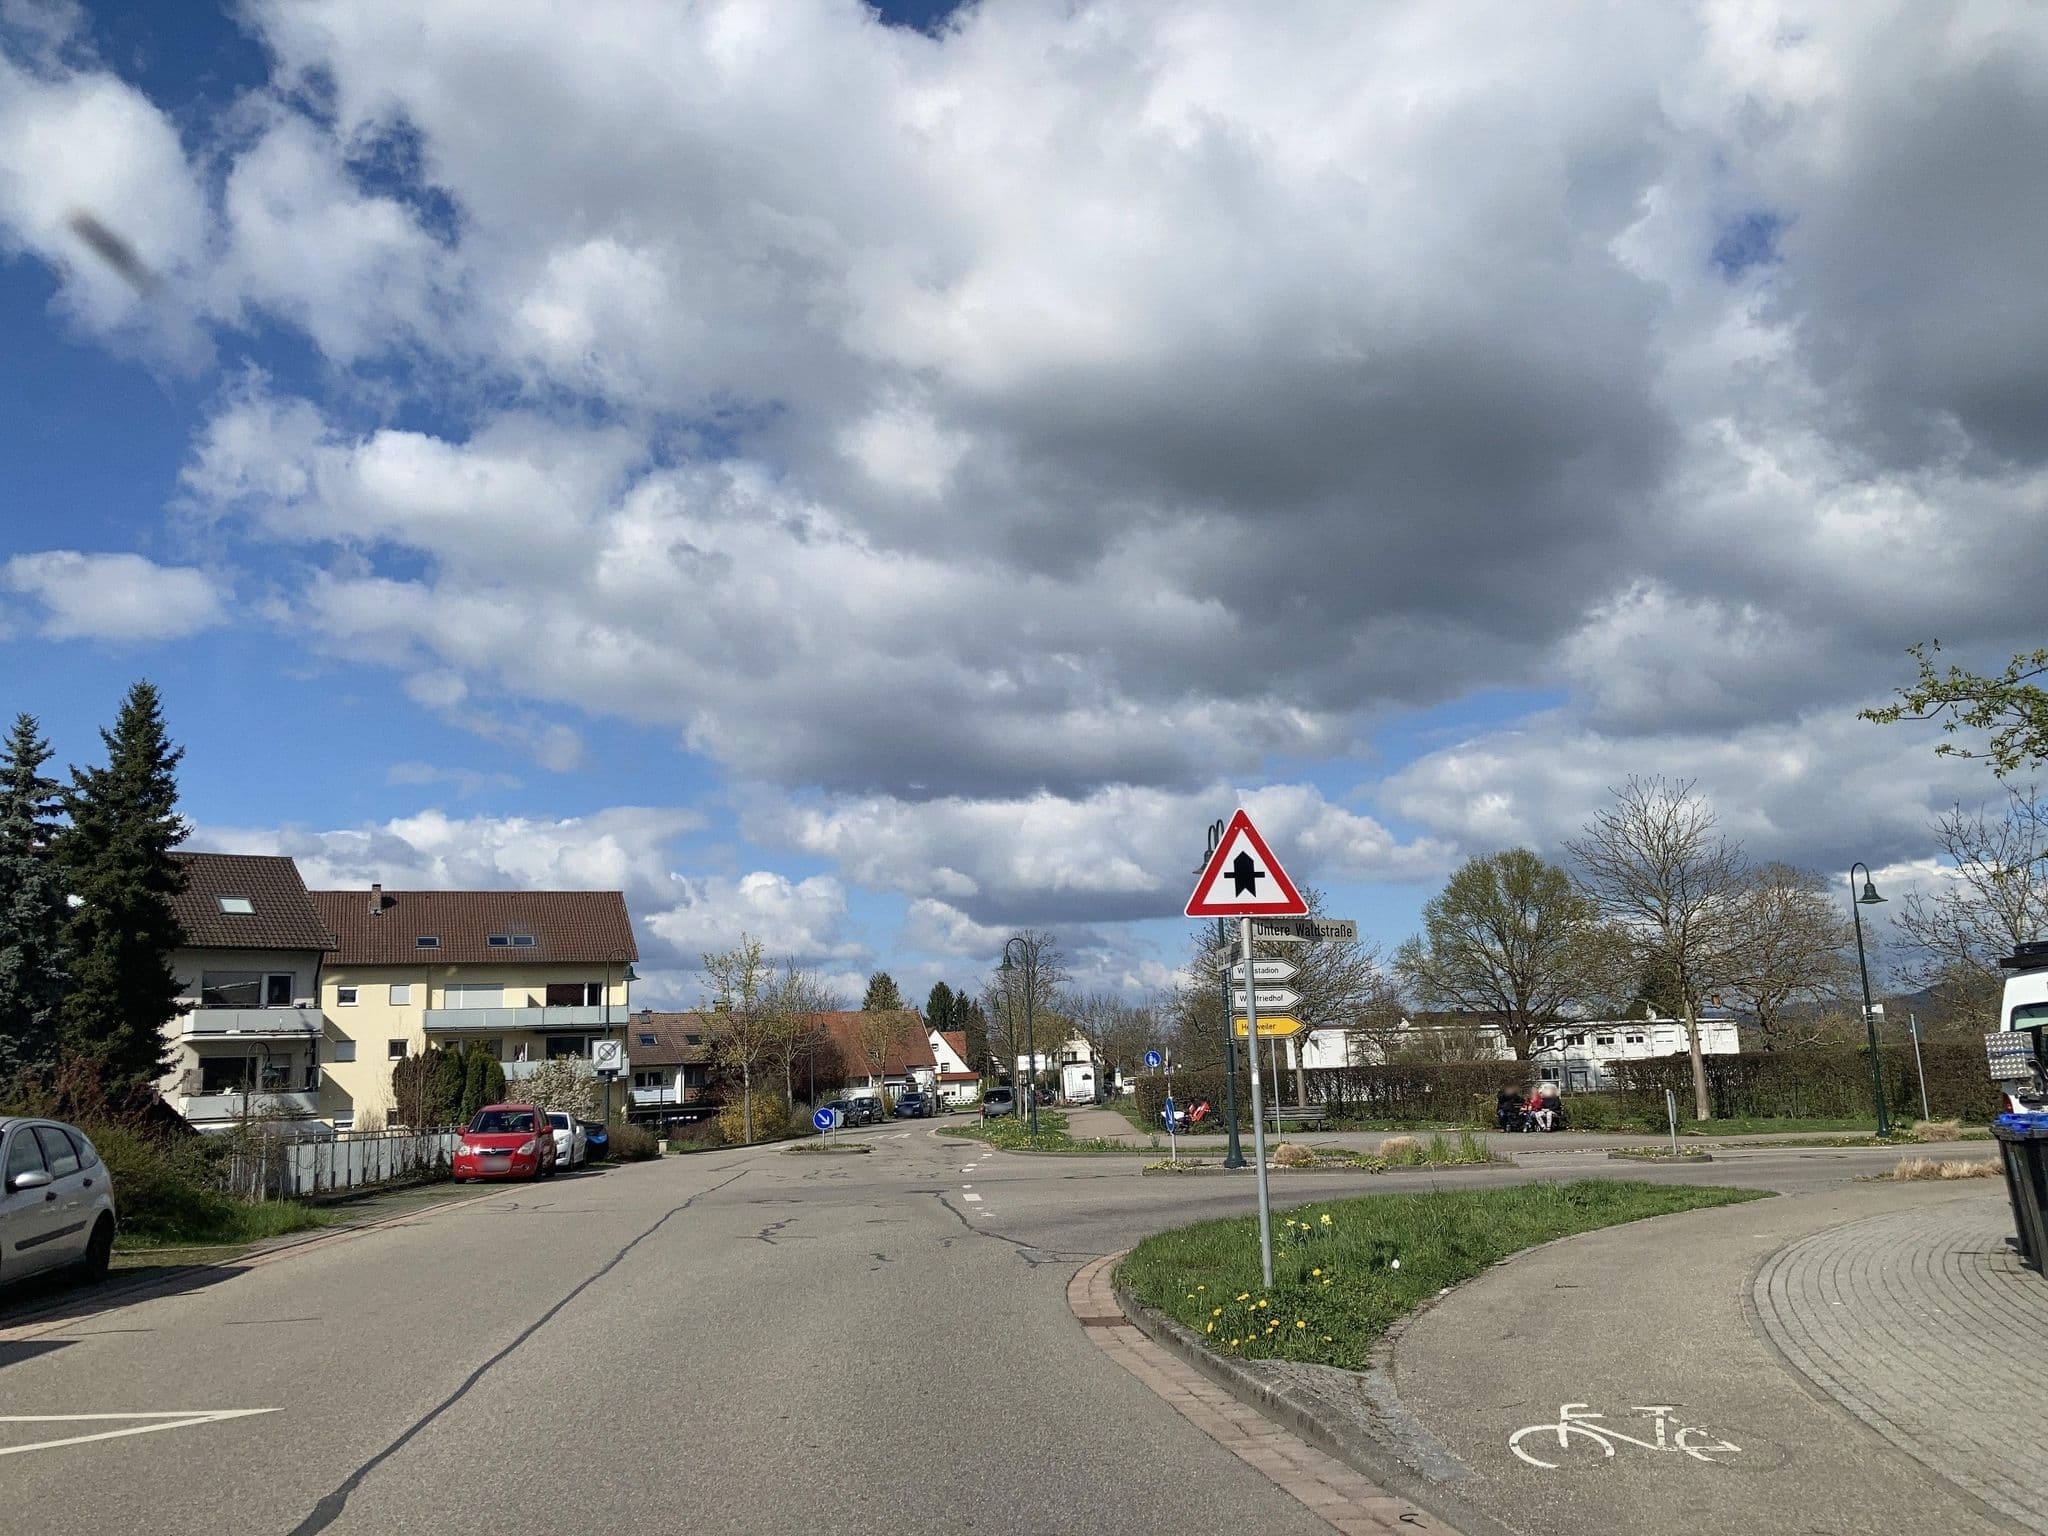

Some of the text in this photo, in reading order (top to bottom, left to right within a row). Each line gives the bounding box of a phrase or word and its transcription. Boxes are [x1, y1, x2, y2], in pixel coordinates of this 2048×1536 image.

[1257, 922, 1353, 937] Untere Waldstraße
[1239, 994, 1283, 1002] Wfriedhof
